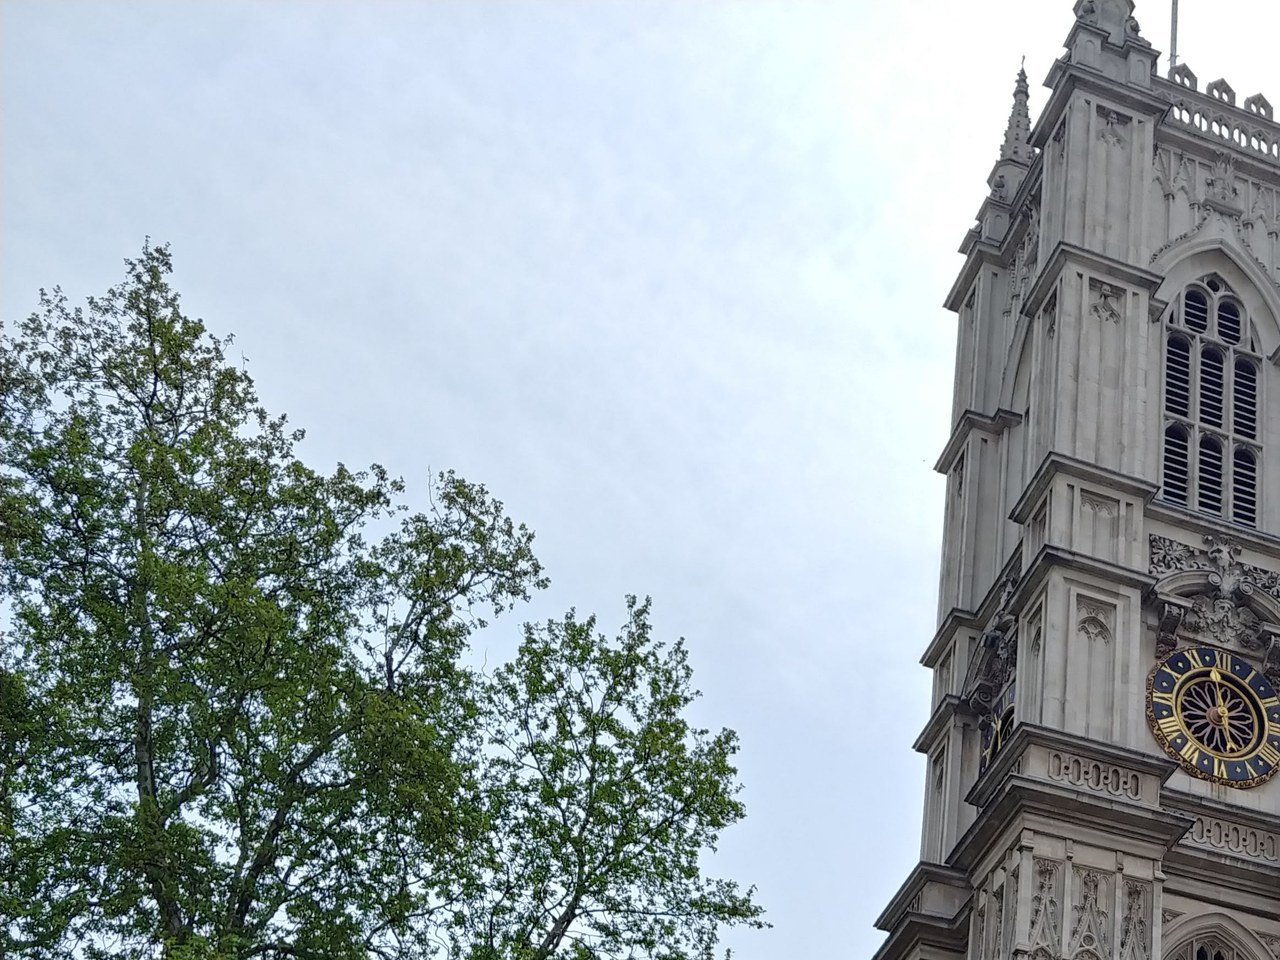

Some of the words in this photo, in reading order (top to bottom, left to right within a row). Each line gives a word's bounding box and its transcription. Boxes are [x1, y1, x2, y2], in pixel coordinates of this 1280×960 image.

[1184, 650, 1203, 669] XI
[1213, 650, 1232, 672] XII
[1160, 665, 1182, 683] X
[1152, 688, 1173, 706] IX
[1262, 695, 1280, 708] II
[1179, 740, 1200, 766] VII
[1213, 757, 1229, 779] VI
[1244, 760, 1258, 779] V
